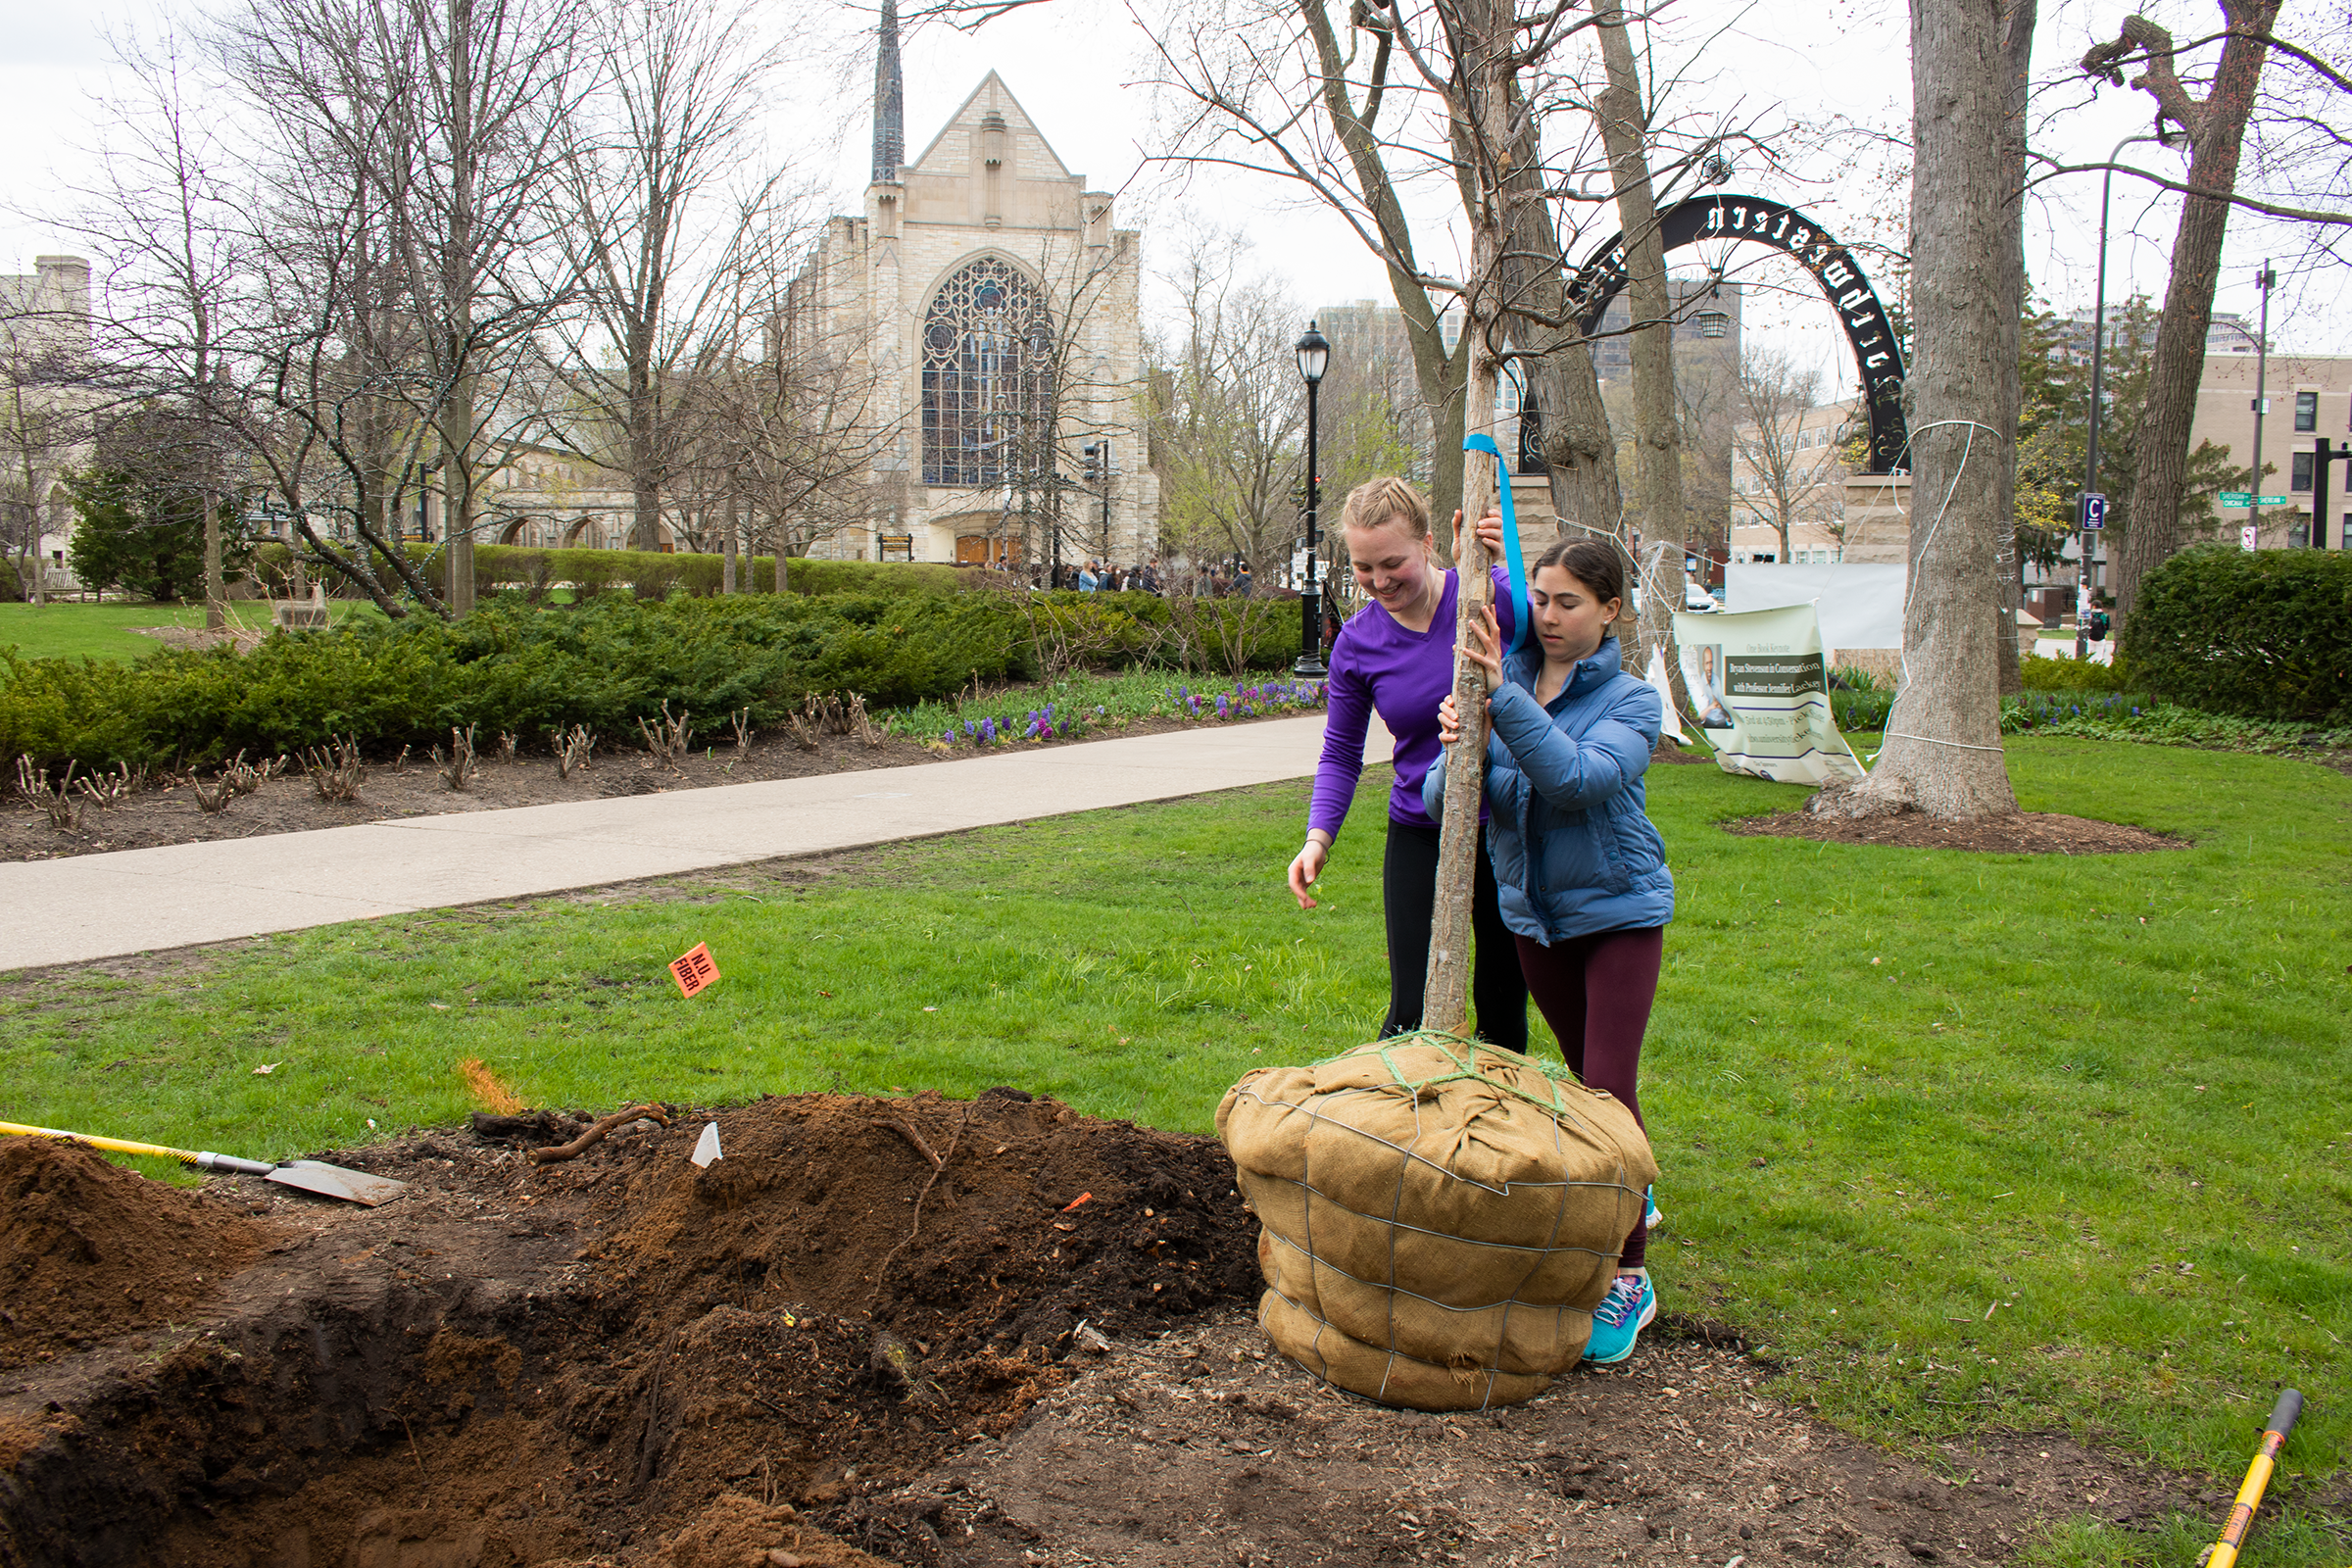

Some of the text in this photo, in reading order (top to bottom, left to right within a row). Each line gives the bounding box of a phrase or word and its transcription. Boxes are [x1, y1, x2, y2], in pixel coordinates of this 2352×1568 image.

[2088, 499, 2100, 518] C
[1746, 643, 1790, 656] One Book Keynote
[1729, 662, 1821, 675] Bryan Stevenson in Conversation
[1733, 680, 1821, 694] with Professor Jennifer Lackey
[674, 956, 700, 992] FIBER
[690, 953, 711, 979] N.U.
